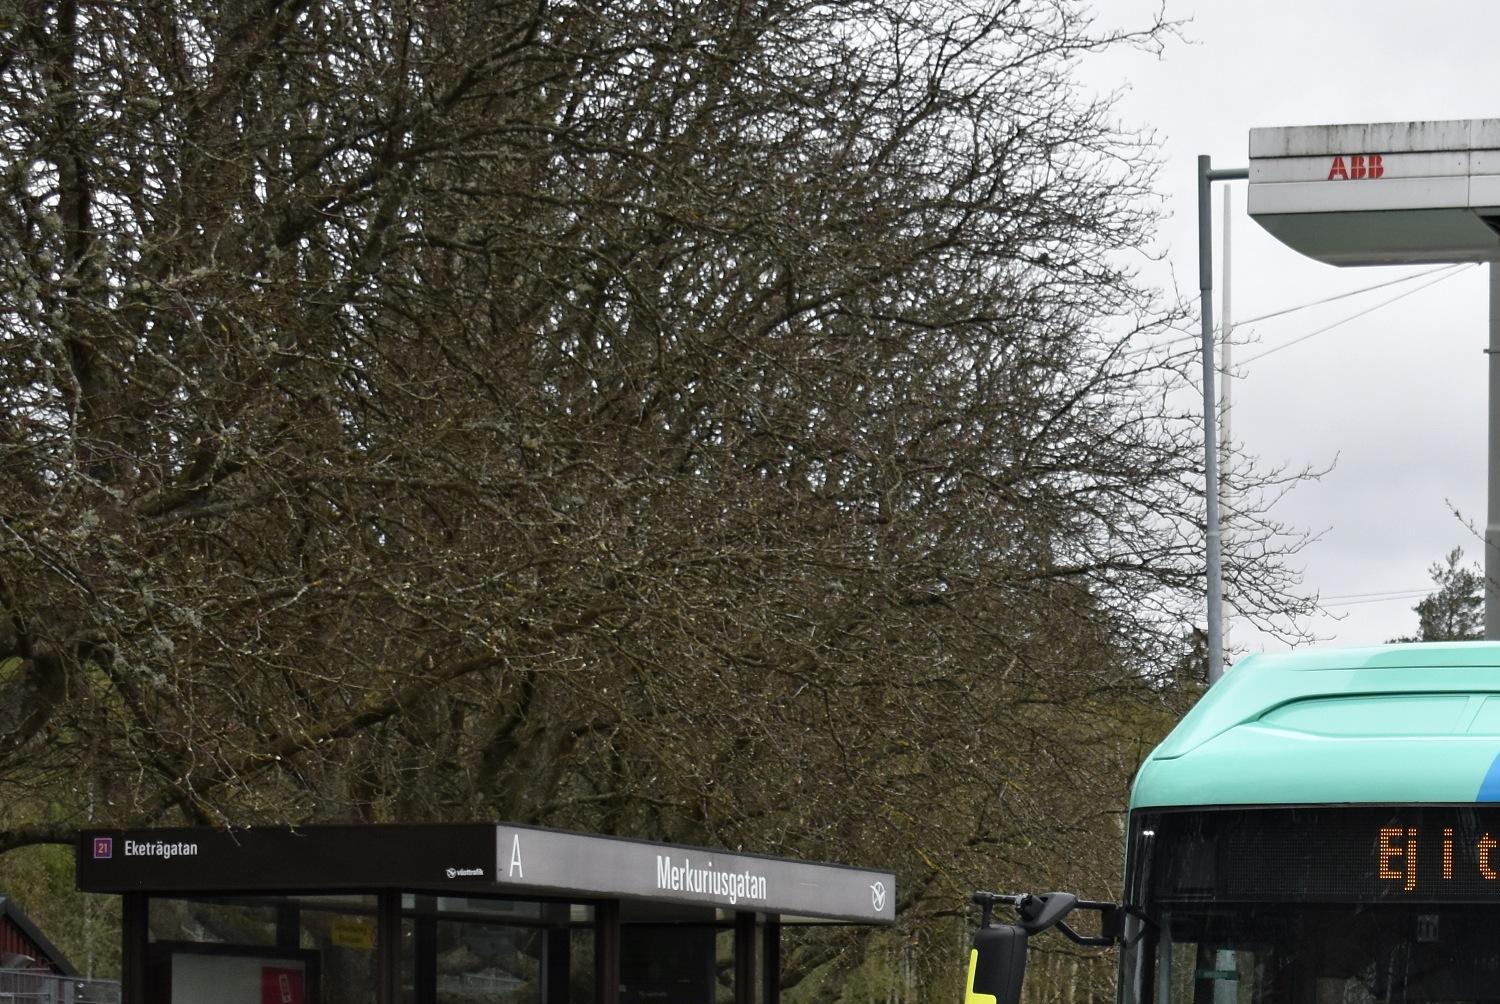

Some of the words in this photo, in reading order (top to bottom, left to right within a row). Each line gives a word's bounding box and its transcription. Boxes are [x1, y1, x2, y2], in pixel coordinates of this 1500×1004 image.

[1328, 154, 1384, 181] ABB
[98, 843, 108, 854] 21
[124, 840, 198, 859] Eketrägatan
[509, 834, 524, 878] A
[1379, 828, 1417, 891] Ej
[1443, 828, 1453, 880] i
[656, 855, 767, 904] Merkuriusgatan
